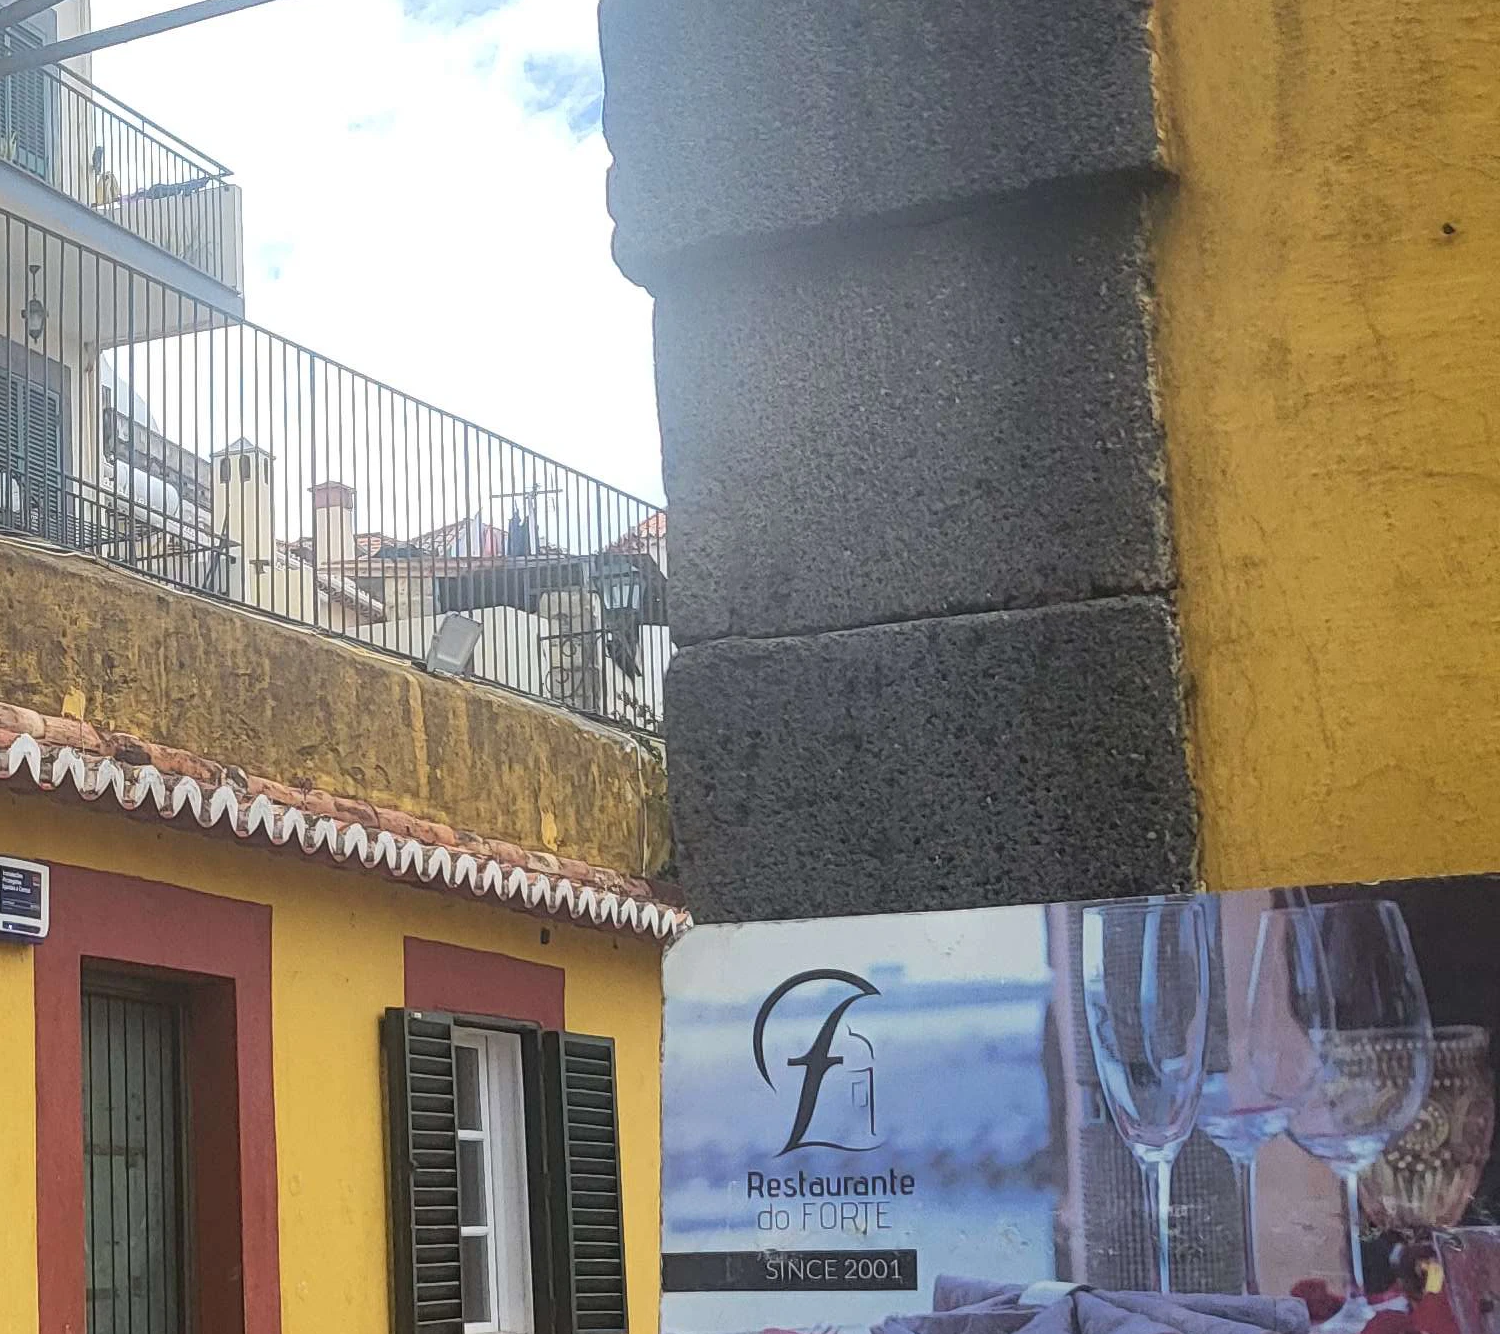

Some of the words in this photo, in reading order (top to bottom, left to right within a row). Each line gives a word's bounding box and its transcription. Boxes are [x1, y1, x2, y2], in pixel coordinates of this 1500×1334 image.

[747, 1168, 915, 1199] Restaurante
[757, 1203, 790, 1231] do
[802, 1200, 893, 1233] FORTE
[765, 1258, 839, 1281] SINCE
[844, 1258, 902, 1280] 2001
